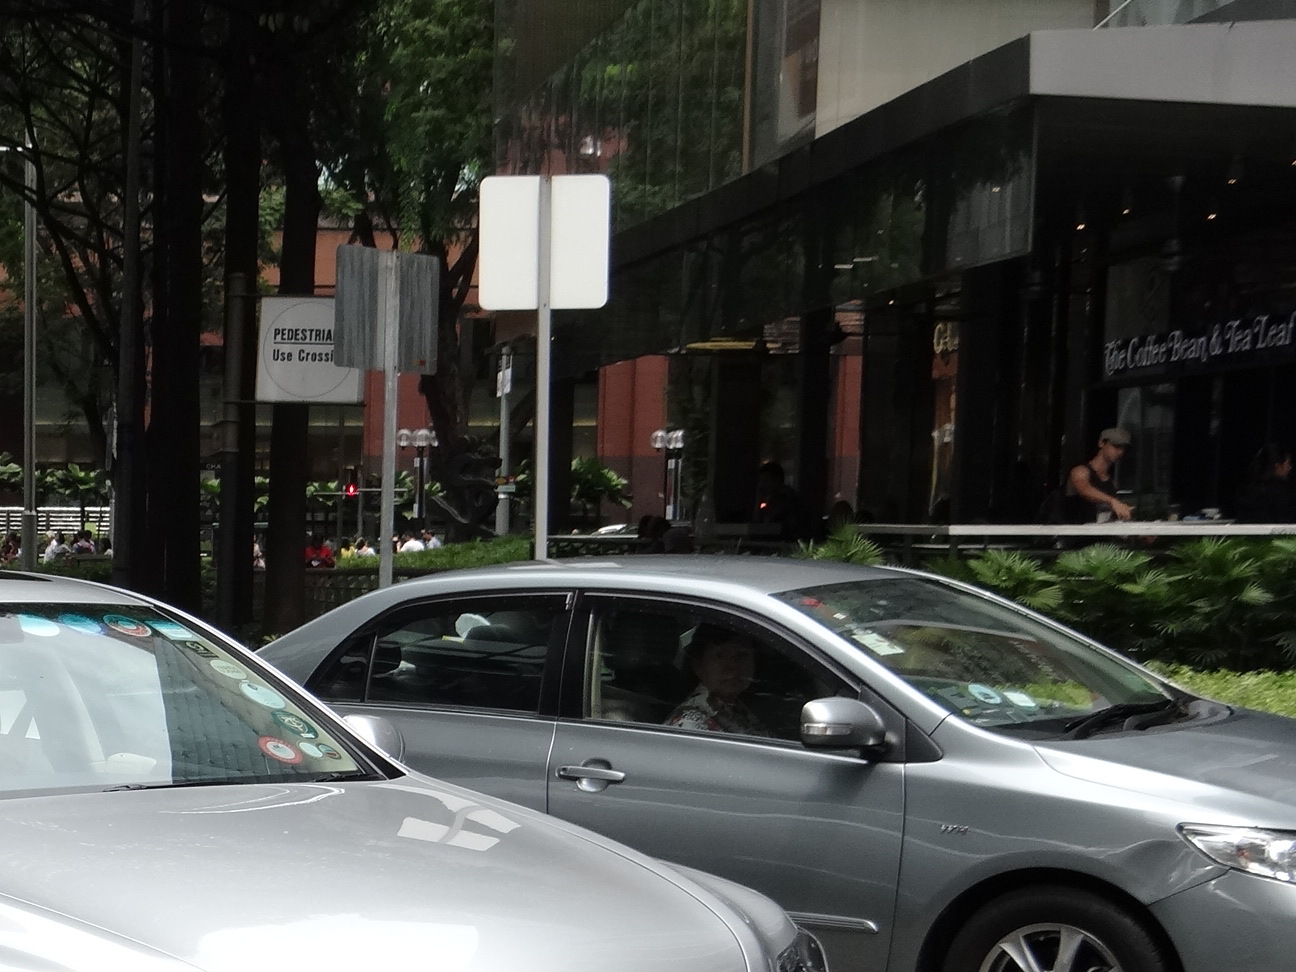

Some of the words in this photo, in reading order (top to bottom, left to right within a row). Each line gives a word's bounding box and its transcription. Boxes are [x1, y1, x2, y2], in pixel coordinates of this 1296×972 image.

[273, 328, 334, 342] PEDESTRIA
[1104, 339, 1126, 375] The
[1127, 335, 1167, 369] Coffee
[1169, 329, 1207, 362] Bean
[1209, 323, 1222, 355] &
[1225, 320, 1253, 353] Tea
[1254, 311, 1296, 348] Leaf
[272, 349, 293, 361] Use
[298, 349, 334, 362] Crossi
